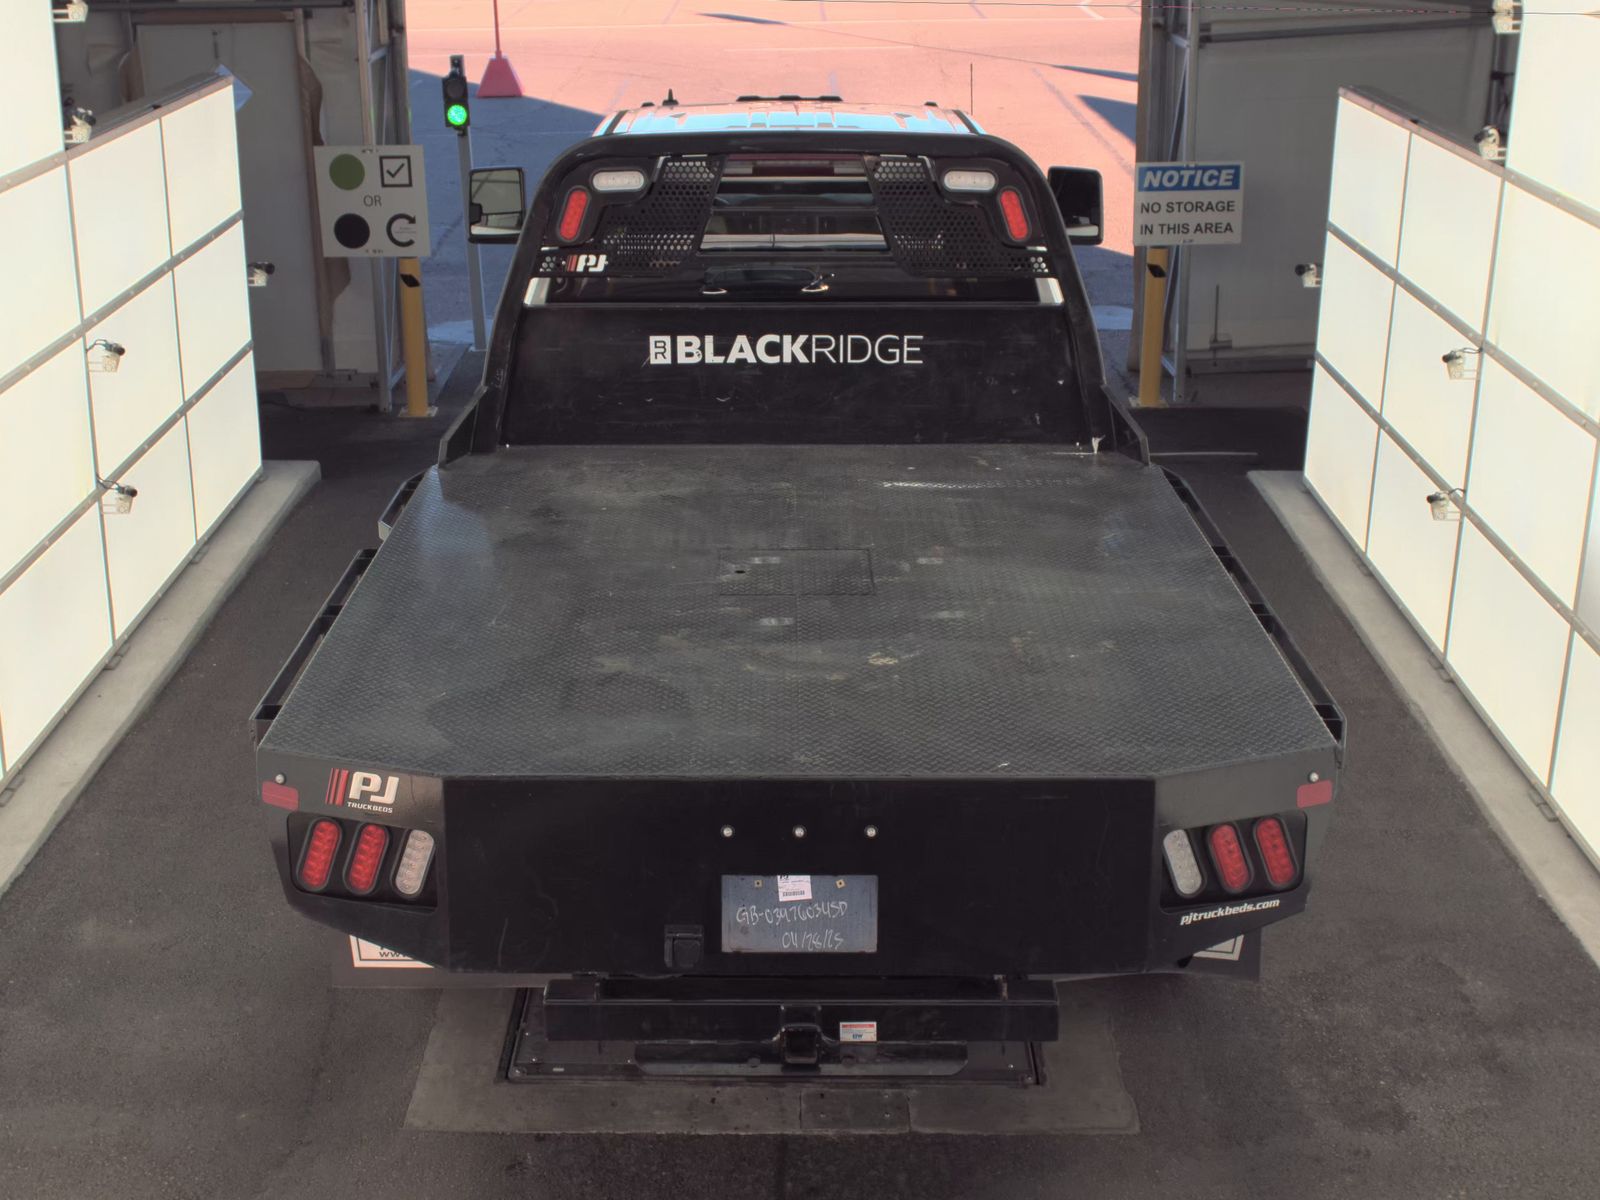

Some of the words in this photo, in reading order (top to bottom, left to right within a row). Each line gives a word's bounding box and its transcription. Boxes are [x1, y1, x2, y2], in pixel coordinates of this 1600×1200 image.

[1144, 169, 1235, 188] NOTICE
[363, 194, 382, 207] OR
[1140, 202, 1161, 214] NO
[1166, 201, 1235, 213] STORAGE
[1140, 223, 1153, 235] IN
[1158, 223, 1190, 234] THIS
[1193, 222, 1234, 234] AREA
[576, 254, 607, 272] PJ
[676, 335, 924, 364] BLACKRIDGE
[348, 771, 400, 805] PJ
[347, 801, 394, 814] TRUCKBEDS
[1180, 899, 1280, 926] pjtruckbeds.com
